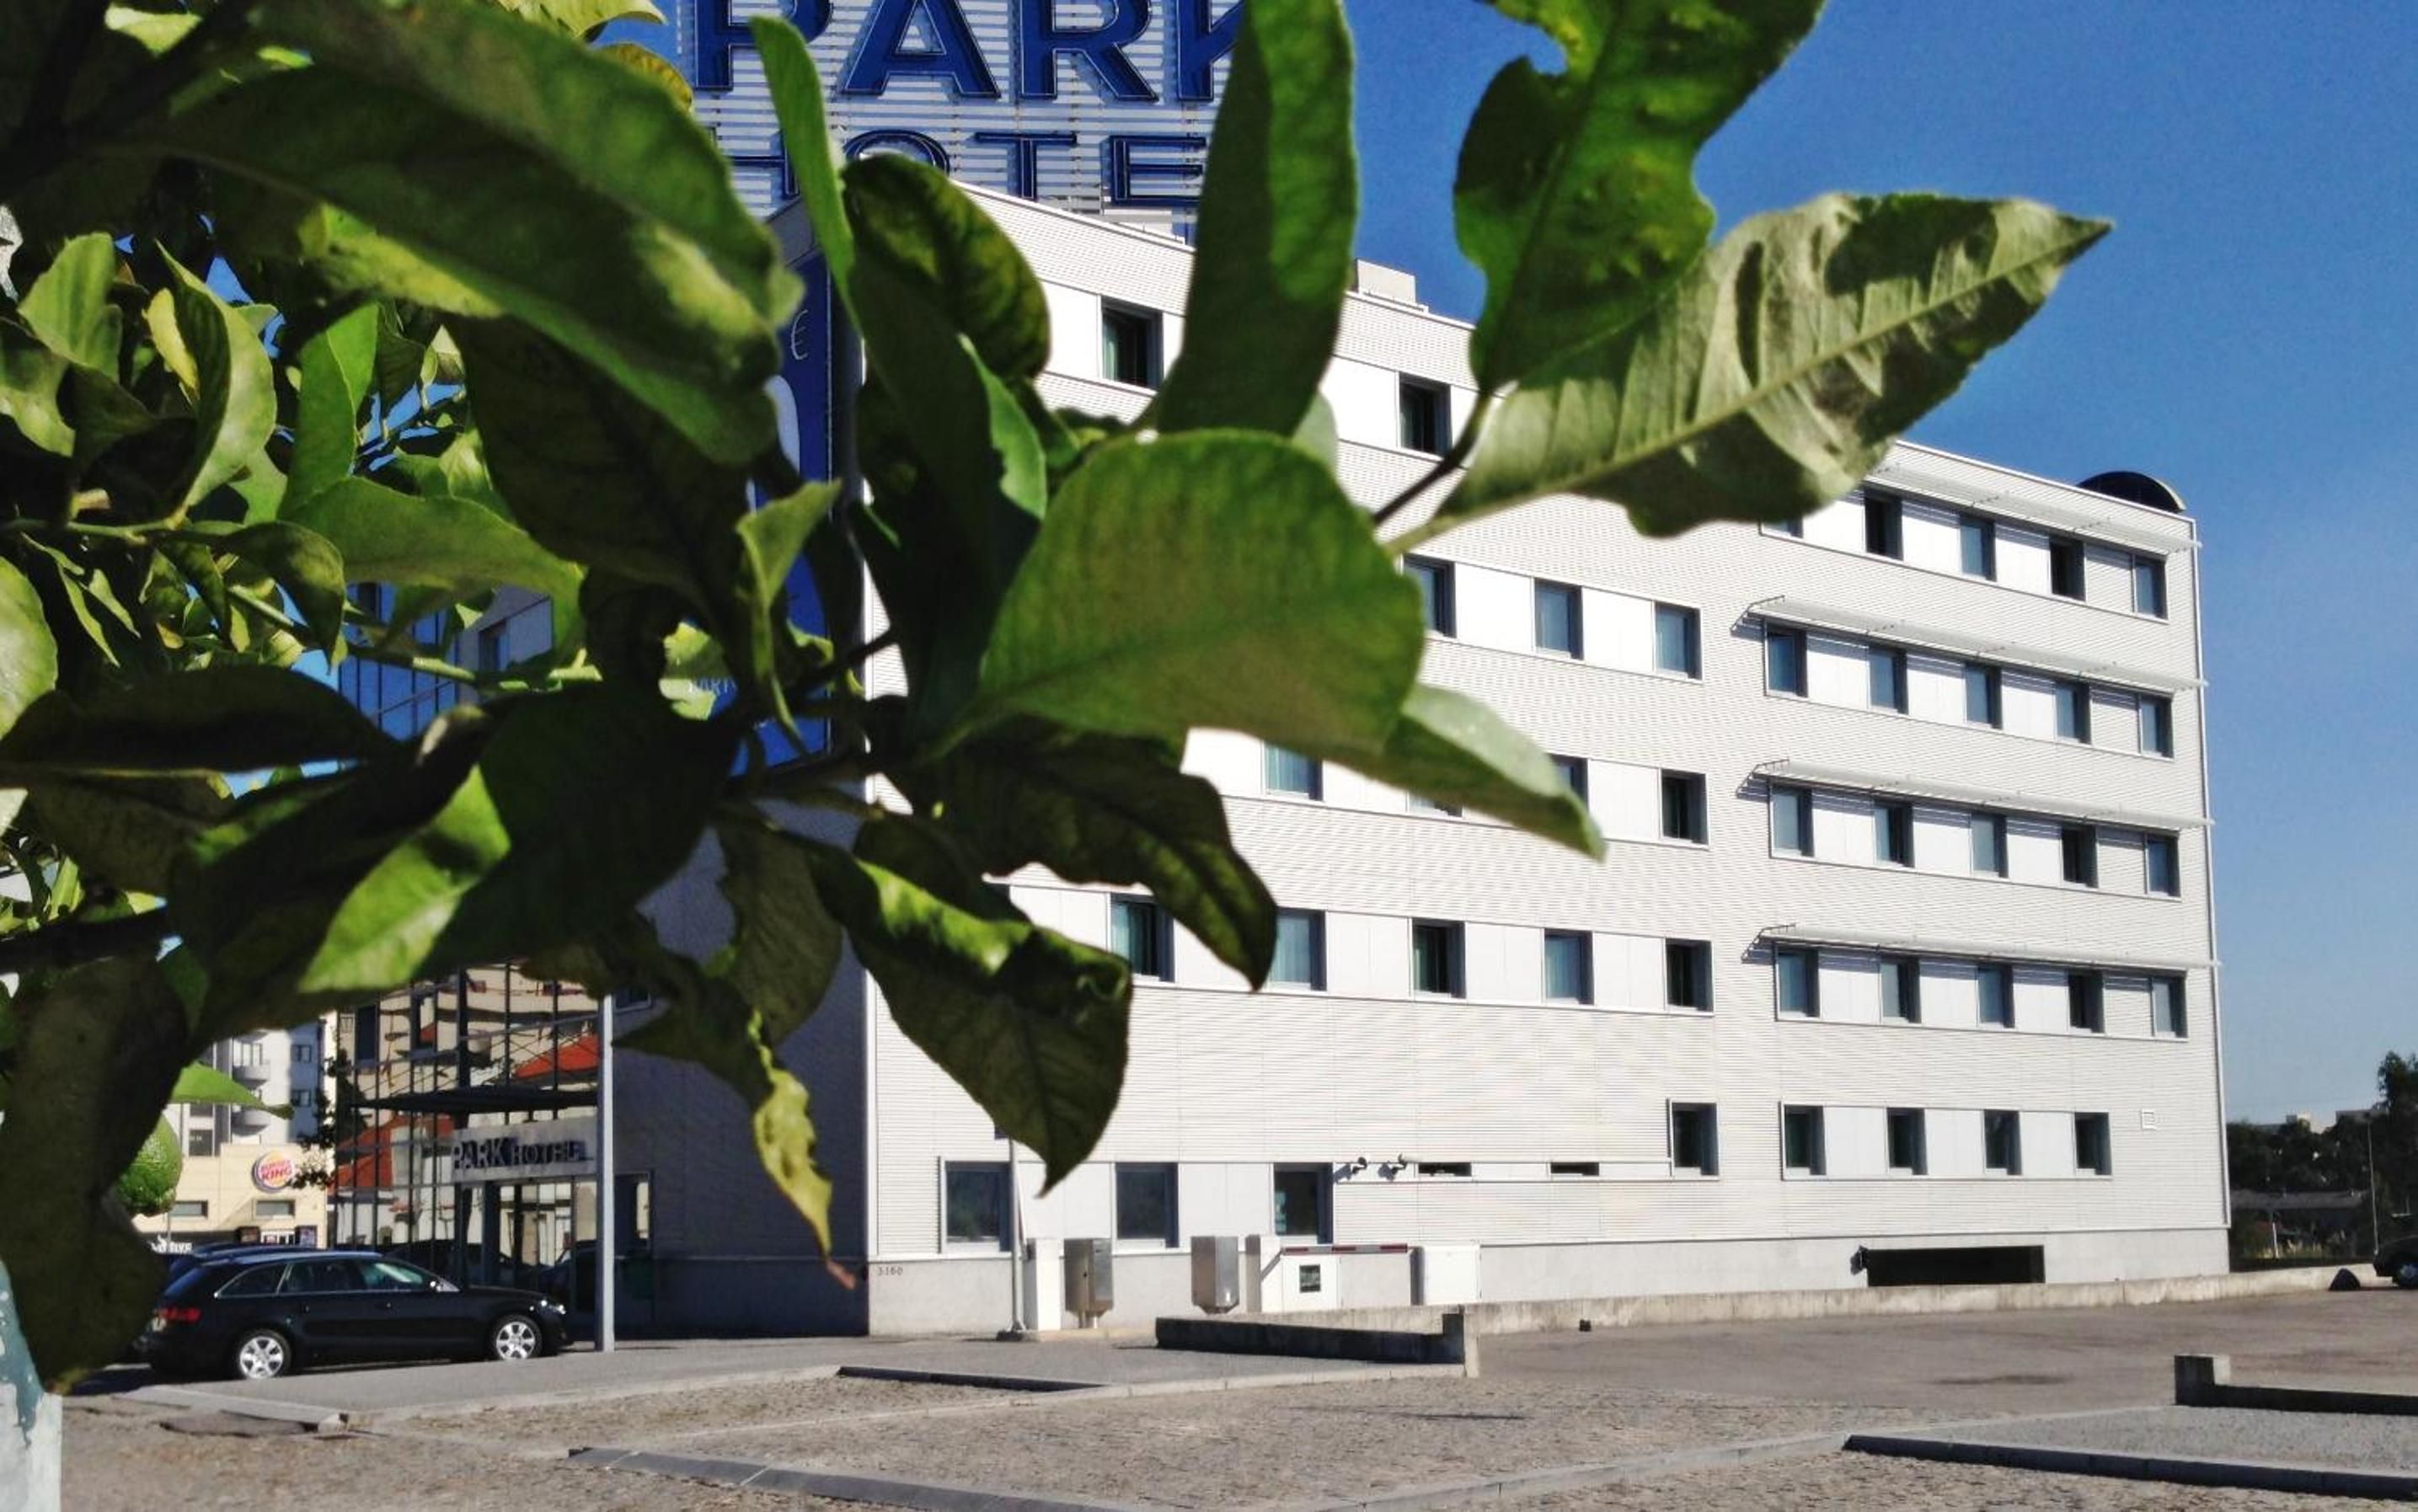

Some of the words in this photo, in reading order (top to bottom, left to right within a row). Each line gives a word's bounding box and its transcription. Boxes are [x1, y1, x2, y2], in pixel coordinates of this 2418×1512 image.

[706, 127, 1206, 208] HOTE
[452, 1137, 509, 1170] PARK
[511, 1141, 591, 1167] HOTEL
[261, 1166, 292, 1181] KING
